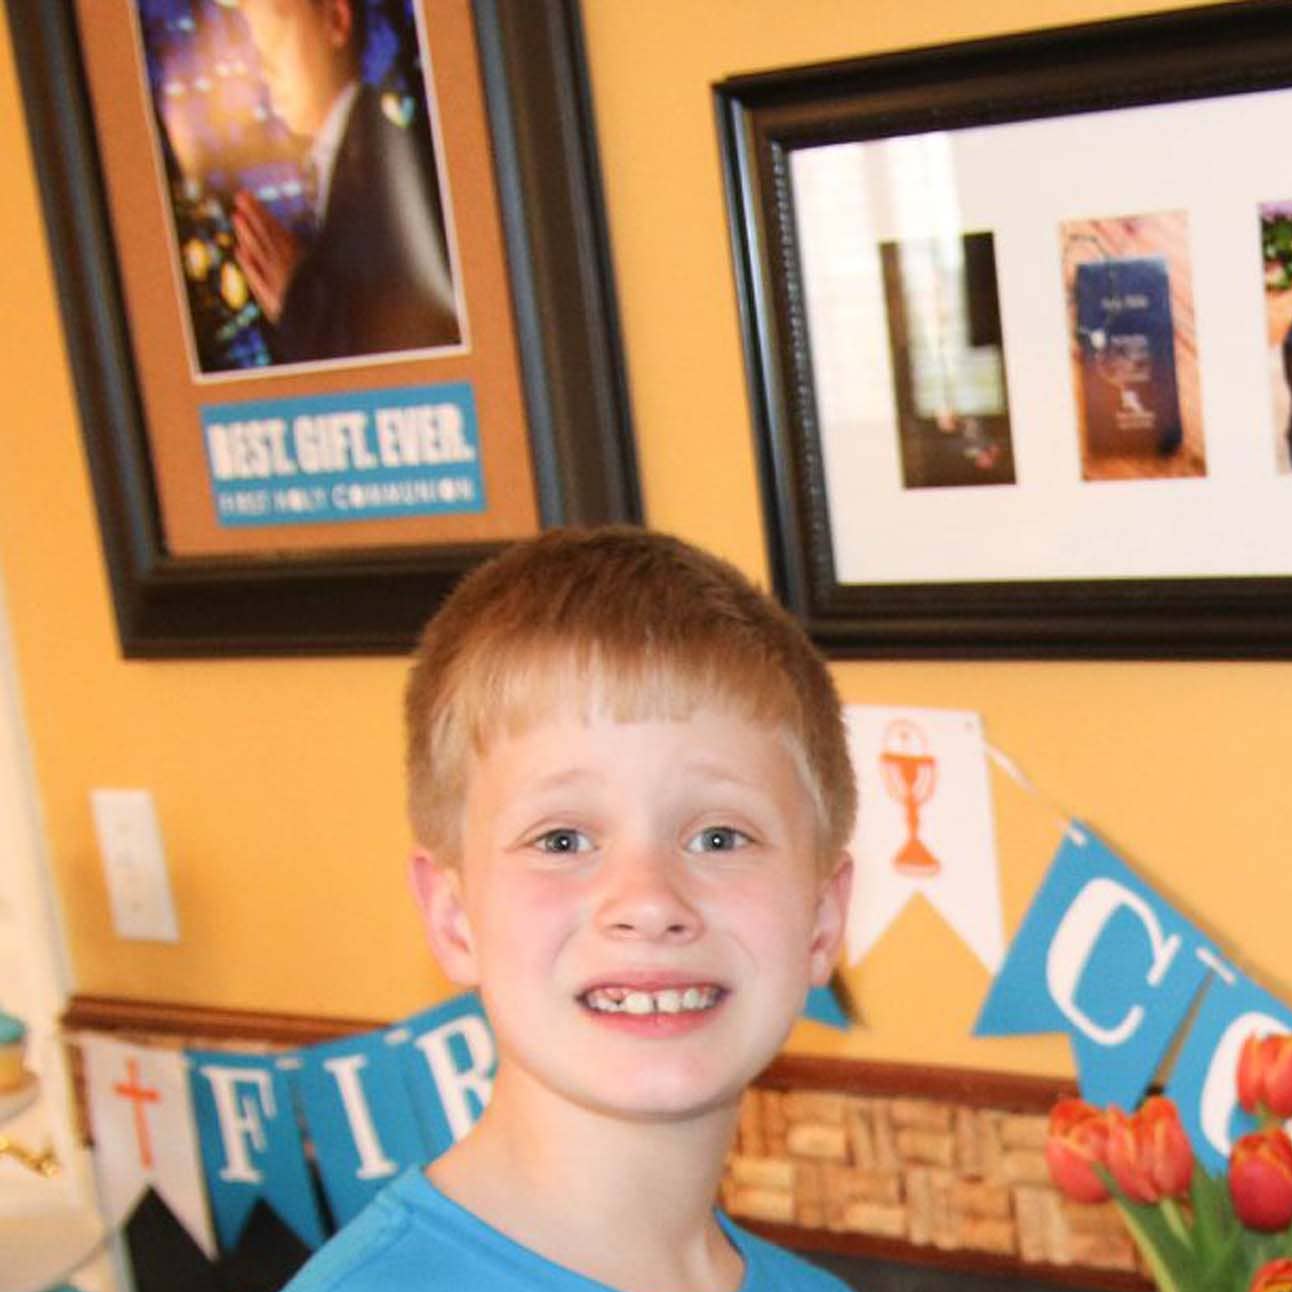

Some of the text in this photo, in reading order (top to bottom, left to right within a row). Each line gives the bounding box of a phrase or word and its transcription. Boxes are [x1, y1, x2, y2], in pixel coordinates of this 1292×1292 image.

[207, 403, 476, 479] BEST. GIFT. EVER.
[330, 477, 473, 511] COMMUNION
